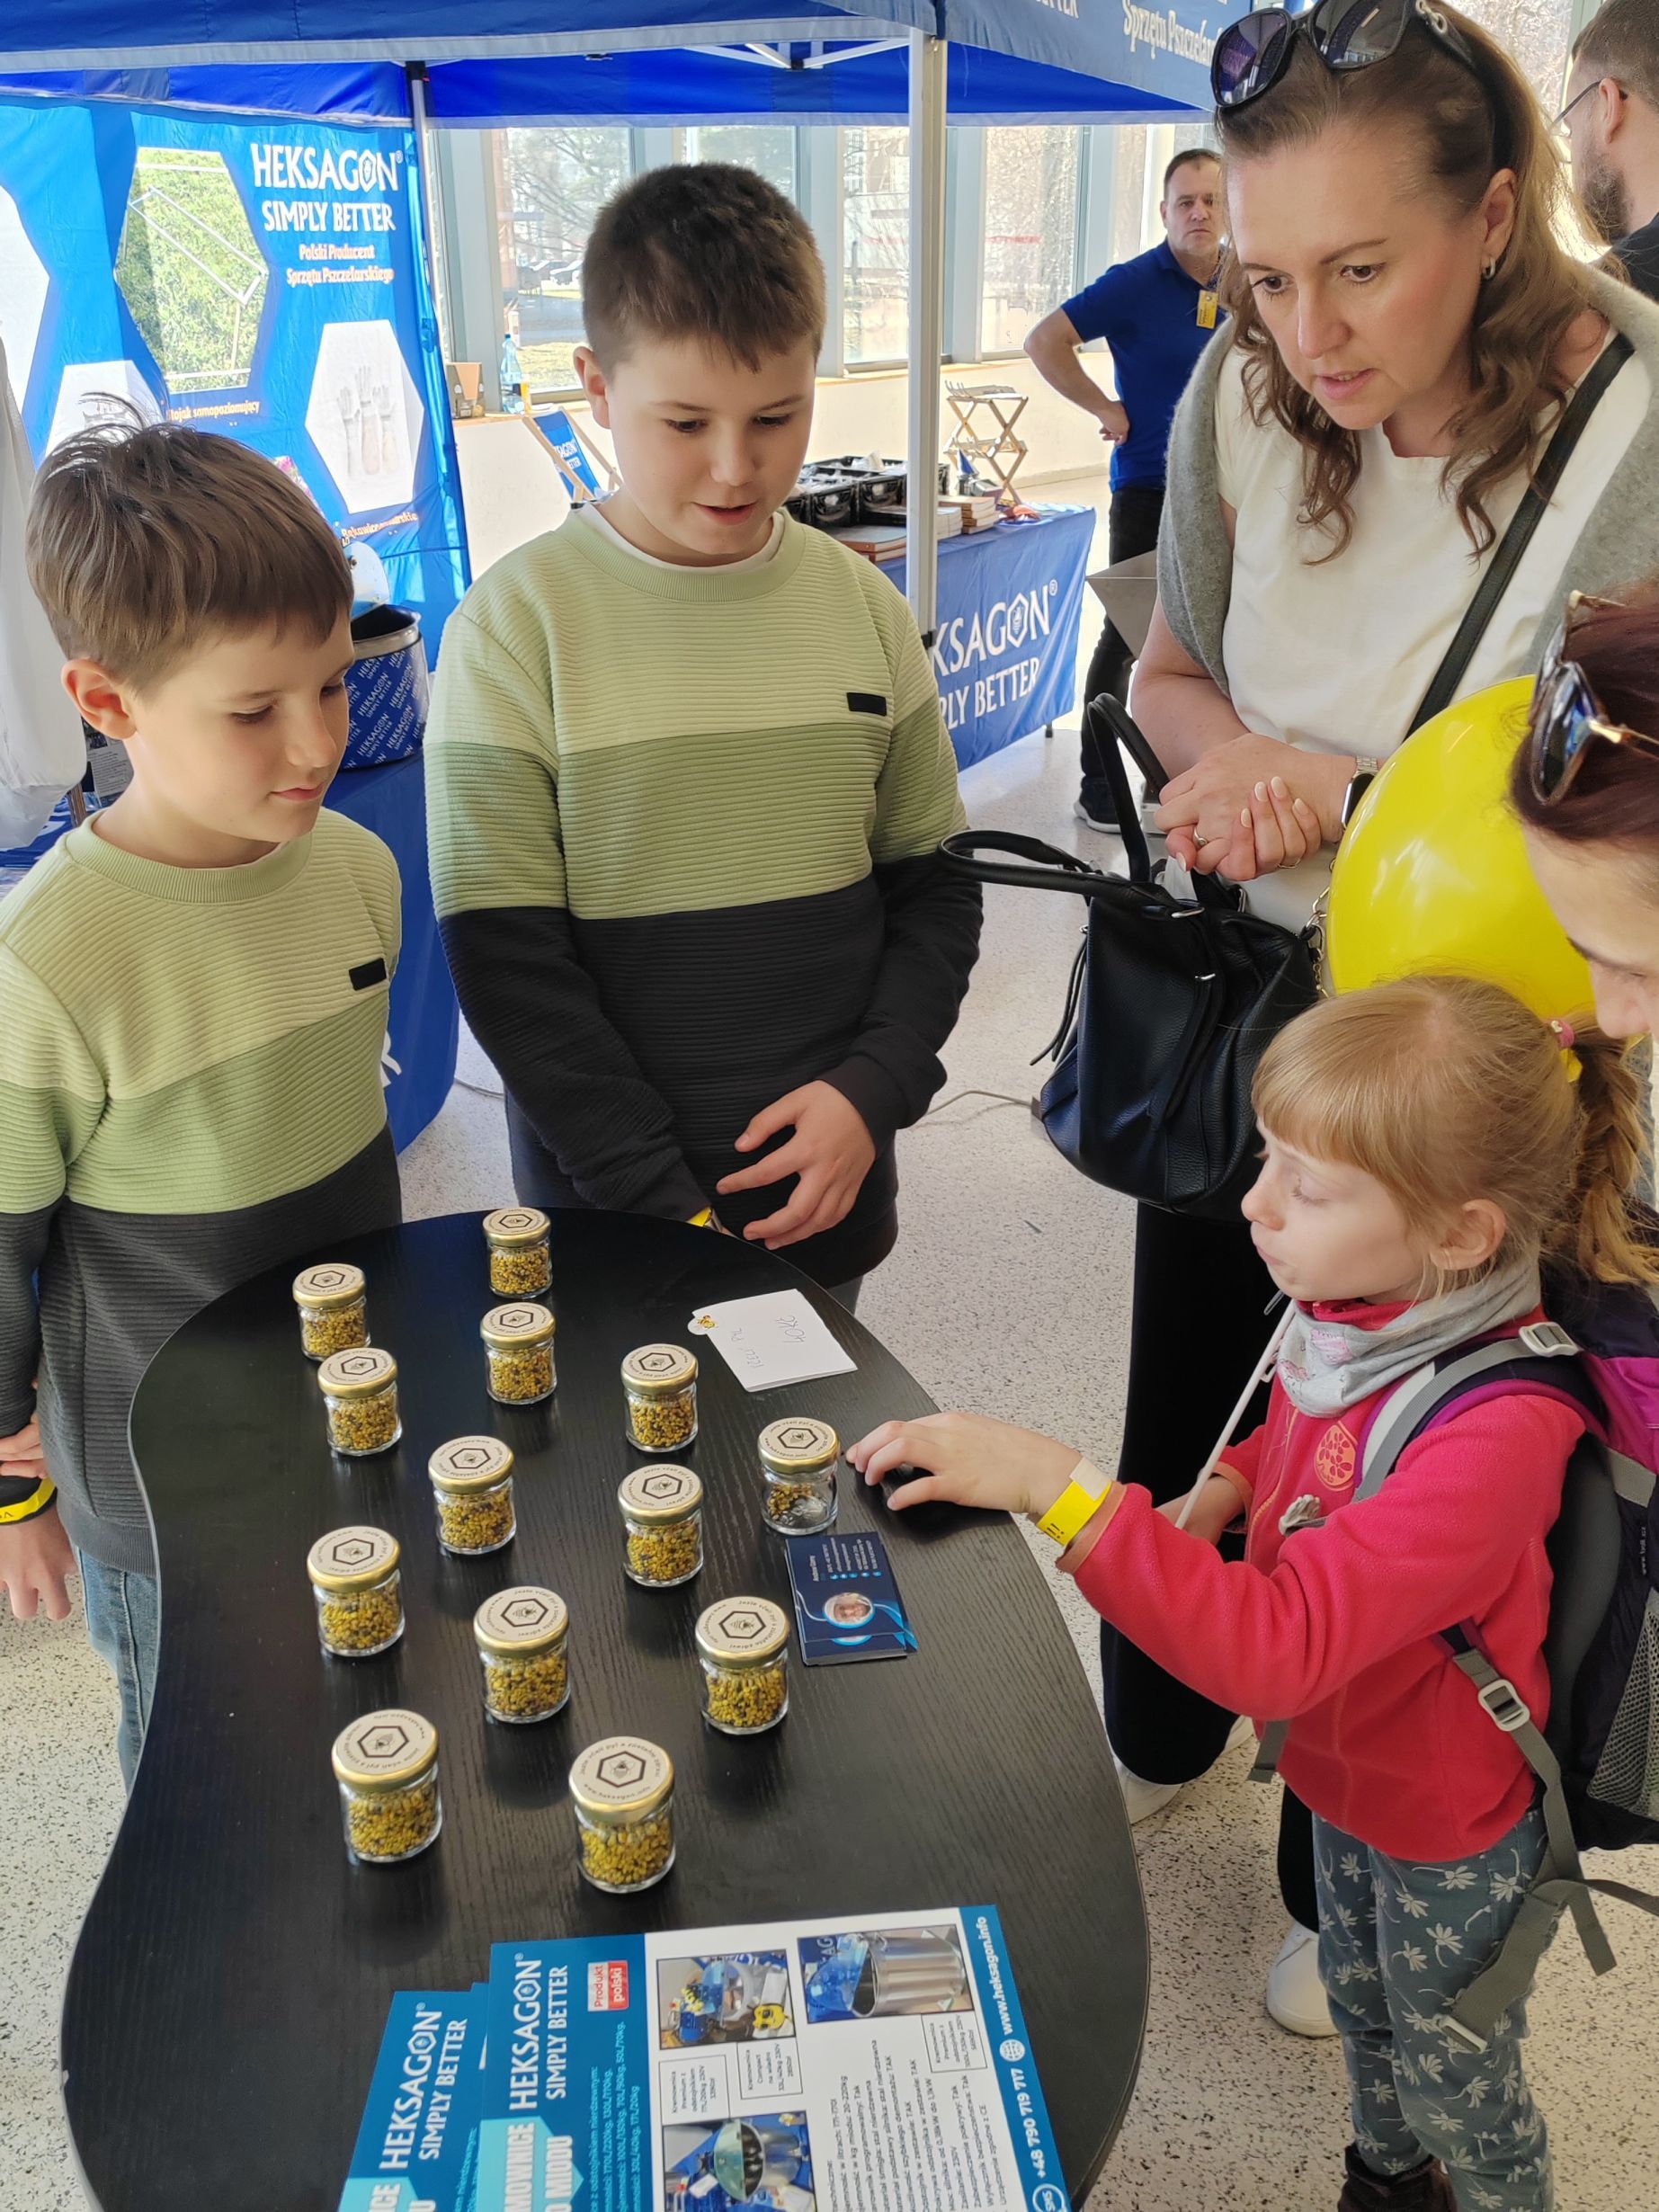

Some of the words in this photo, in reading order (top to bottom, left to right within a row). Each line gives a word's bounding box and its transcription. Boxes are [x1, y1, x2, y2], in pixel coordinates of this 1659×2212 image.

[1123, 3, 1166, 59] Sprzętu
[262, 201, 328, 232] SIMPLY
[333, 202, 397, 232] BETTER
[299, 244, 328, 261] Polski
[328, 244, 376, 261] Producent
[286, 267, 323, 288] Sprzętu
[322, 265, 396, 285] Pszczelarskiego
[930, 579, 1058, 679] KSAGON®
[939, 684, 971, 731] PLY
[975, 657, 1041, 718] BETTER
[593, 1966, 603, 2007] Produkt
[610, 1967, 625, 2002] polski
[977, 1915, 1014, 2036] www.heksagon.info
[548, 1965, 568, 2029] BETTER
[434, 2018, 468, 2086] BETTER
[885, 2056, 893, 2072] TAK
[545, 2034, 567, 2100] SIMPLY
[909, 2059, 917, 2075] TAK
[1010, 2068, 1027, 2091] 717
[852, 2085, 861, 2100] Tak
[951, 2085, 959, 2100] Tak
[961, 2074, 969, 2090] Tak
[905, 2101, 913, 2118] TAK
[978, 2104, 987, 2116] CE
[1017, 2092, 1033, 2116] 719
[418, 2091, 453, 2160] SIMPLY
[1023, 2118, 1040, 2147] 790
[504, 2122, 534, 2212] MOWNICE
[544, 2135, 574, 2199] MIODU
[850, 2147, 858, 2158] kg
[950, 2145, 960, 2166] 230V
[1030, 2149, 1047, 2179] +48
